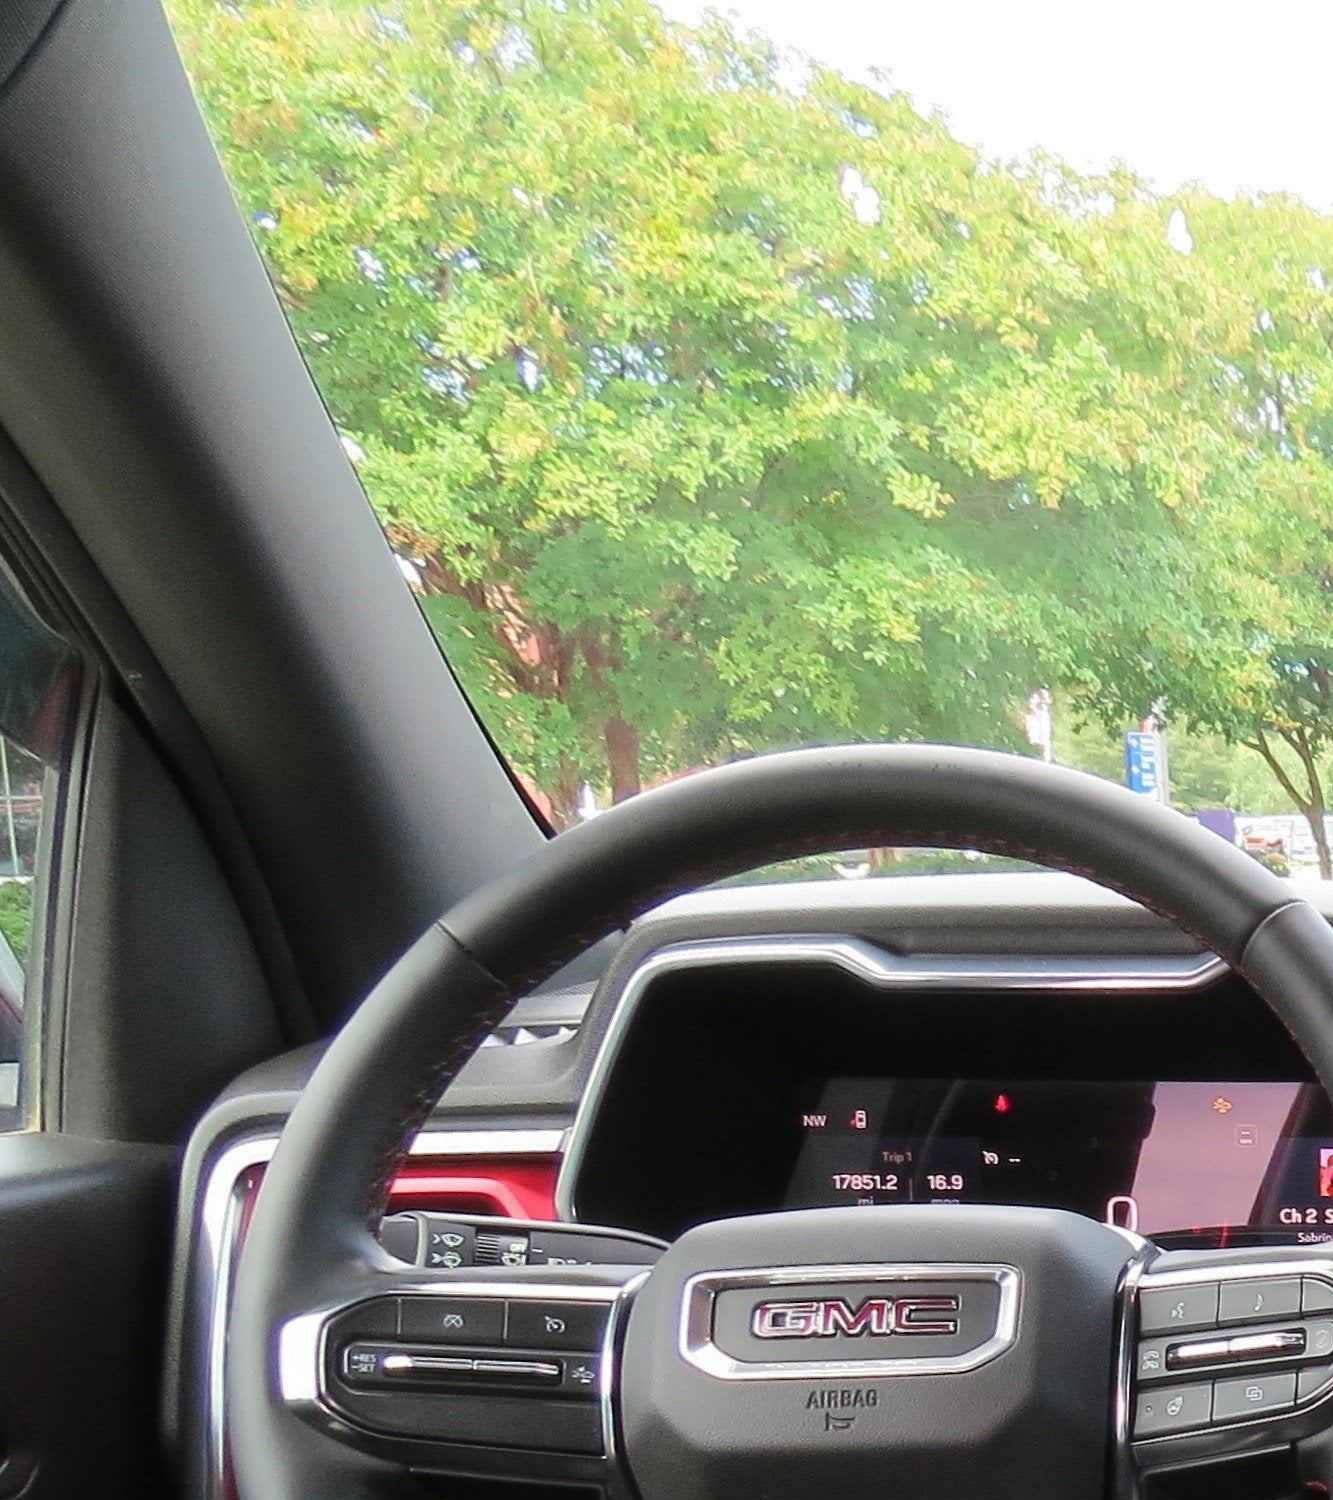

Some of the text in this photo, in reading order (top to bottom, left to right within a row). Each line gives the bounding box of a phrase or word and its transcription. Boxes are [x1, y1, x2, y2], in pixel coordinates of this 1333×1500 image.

[803, 1114, 827, 1127] NW
[882, 1151, 905, 1165] Trip
[832, 1174, 963, 1191] 17851.2 16.9
[1280, 1208, 1302, 1224] Ch
[1305, 1208, 1318, 1224] 2
[751, 1296, 960, 1340] GMC
[806, 1389, 878, 1410] AIRBAG
